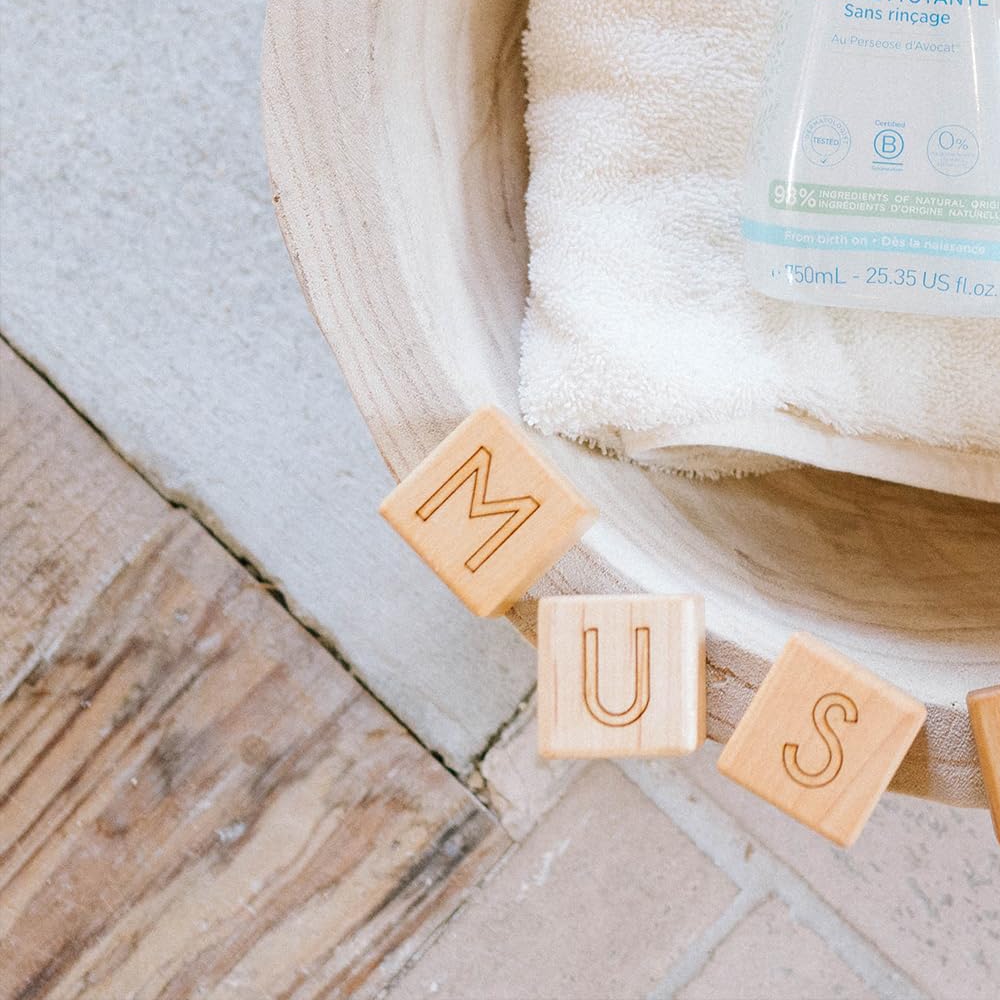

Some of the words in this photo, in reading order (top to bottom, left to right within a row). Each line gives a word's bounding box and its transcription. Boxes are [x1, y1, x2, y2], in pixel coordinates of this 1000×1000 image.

[844, 4, 883, 20] Sans
[888, 7, 951, 27] rinçage
[831, 34, 848, 45] Au
[813, 136, 840, 147] TESTED
[882, 135, 896, 153] B
[818, 190, 889, 202] INGREDIENTS
[894, 194, 910, 203] OF
[915, 196, 965, 208] NATURAL
[784, 230, 815, 243] From
[817, 231, 848, 244] birth
[851, 235, 868, 246] on
[909, 237, 921, 249] la
[866, 266, 917, 287] 25.35
[922, 271, 950, 292] US
